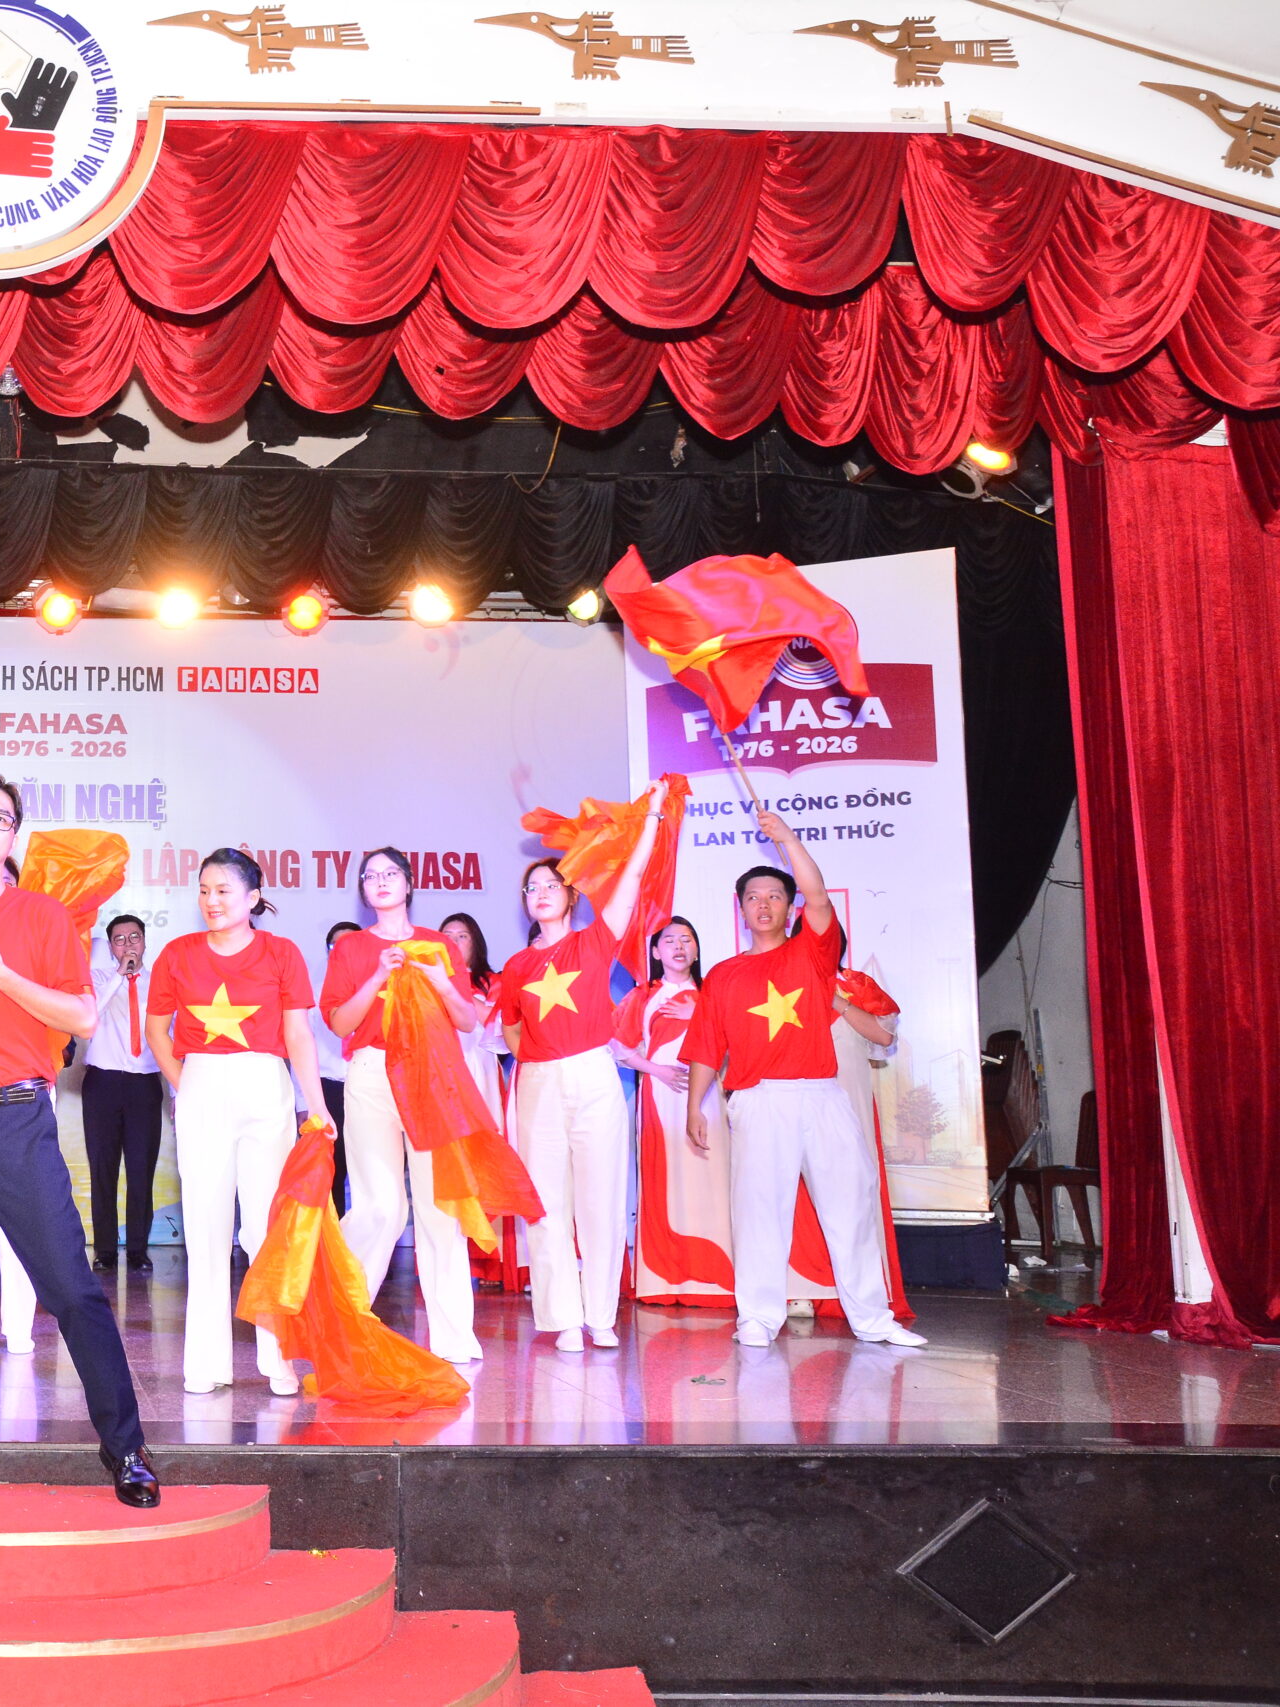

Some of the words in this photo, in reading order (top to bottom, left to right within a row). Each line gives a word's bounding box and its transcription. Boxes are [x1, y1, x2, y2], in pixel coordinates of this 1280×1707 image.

[77, 38, 114, 85] TP.HCM
[91, 86, 123, 124] ĐỘNG
[87, 127, 115, 154] LAO
[71, 154, 105, 186] HÓA
[40, 177, 81, 212] VĂN
[22, 660, 78, 691] SÁCH
[84, 666, 164, 692] TP.HCM
[180, 668, 318, 692] FAHASA
[70, 740, 127, 758] 2026
[796, 736, 858, 755] 2026
[20, 777, 63, 820] ĂN
[74, 777, 165, 829] NGHỆ
[686, 801, 733, 820] HỤC
[776, 793, 840, 815] CỘNG
[845, 788, 912, 809] ĐỒNG
[693, 831, 736, 847] LAN
[834, 819, 895, 842] THỨC
[143, 841, 199, 894] LẬP
[312, 851, 352, 889] TY
